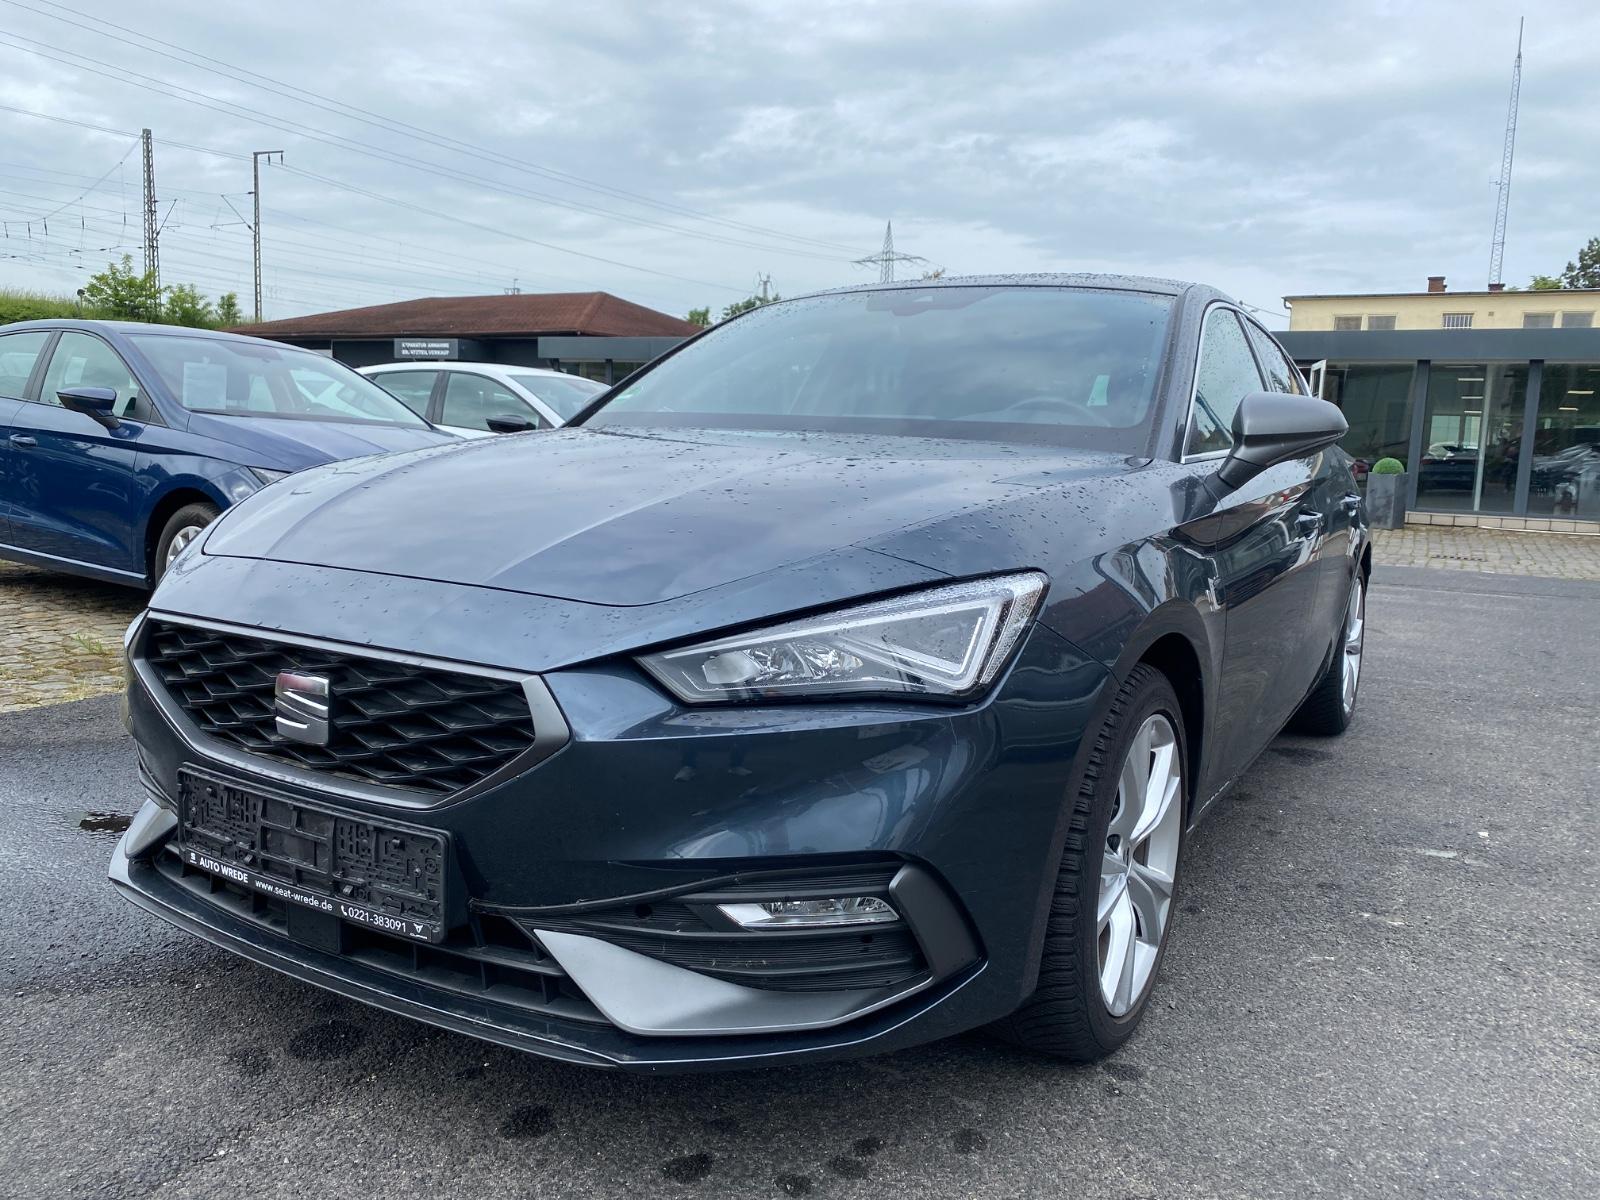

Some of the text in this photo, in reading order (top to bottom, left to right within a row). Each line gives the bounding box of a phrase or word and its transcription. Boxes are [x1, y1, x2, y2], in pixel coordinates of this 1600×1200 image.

[200, 857, 406, 933] AUTO WREDE www.seat-wrede.de 0221-383091
